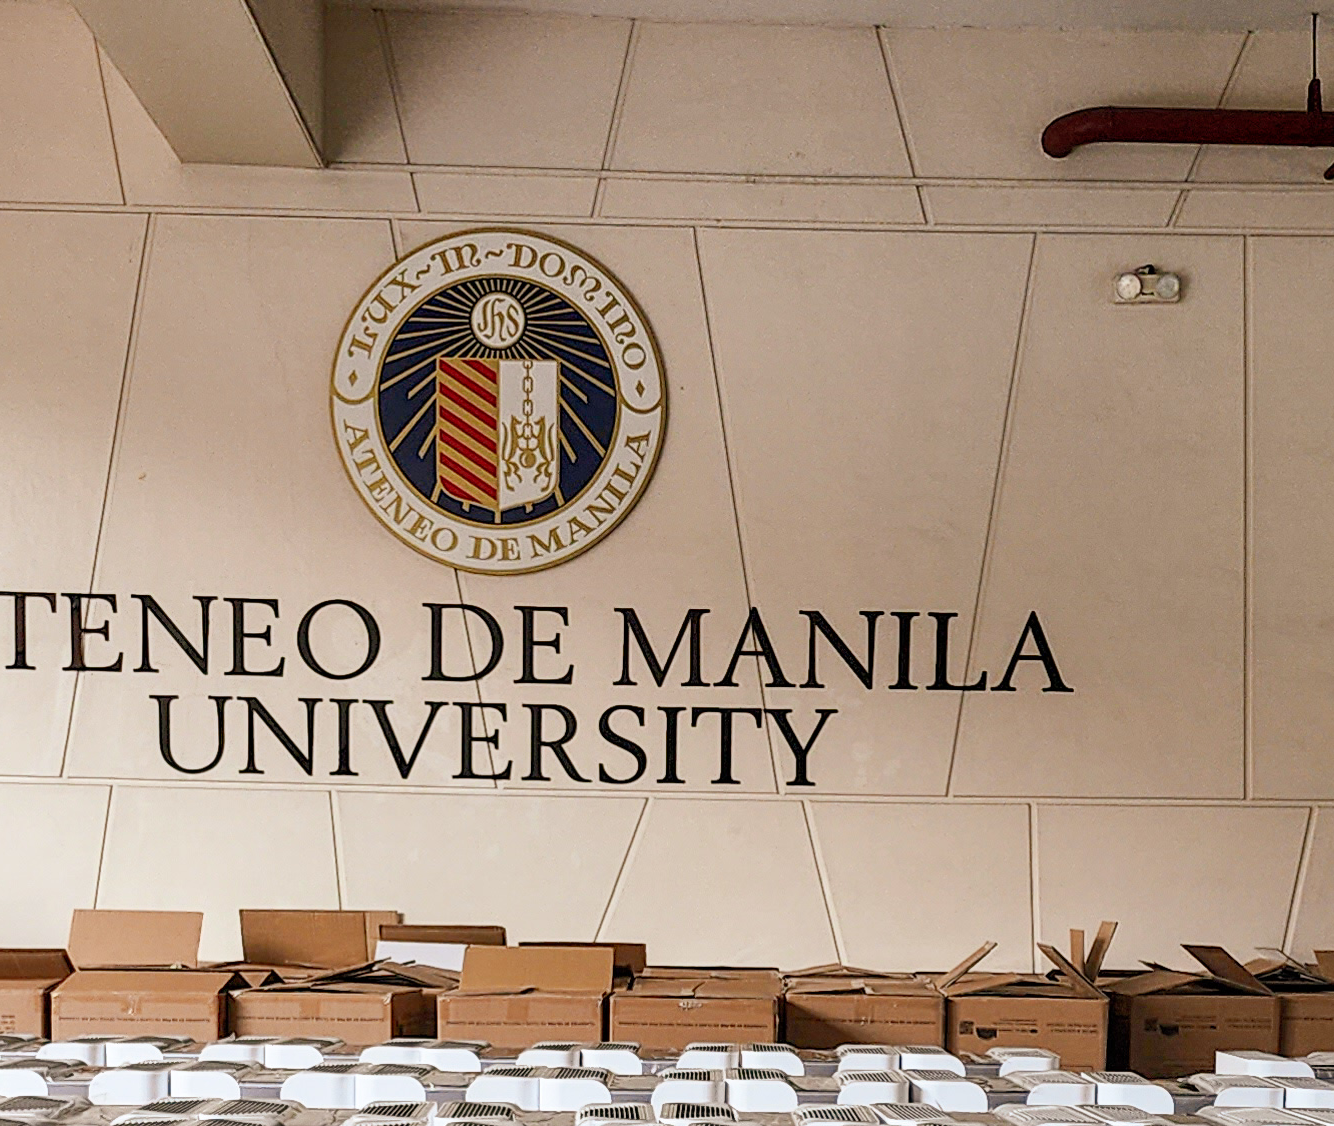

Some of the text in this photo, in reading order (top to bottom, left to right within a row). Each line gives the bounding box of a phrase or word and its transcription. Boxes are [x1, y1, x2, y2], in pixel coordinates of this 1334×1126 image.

[348, 268, 421, 360] LUX
[506, 242, 648, 372] DOMINO
[343, 418, 652, 562] ATENEO DE MANILA
[422, 602, 574, 685] DE
[613, 597, 1074, 693] MANILA
[149, 694, 838, 787] UNIVERSITY
